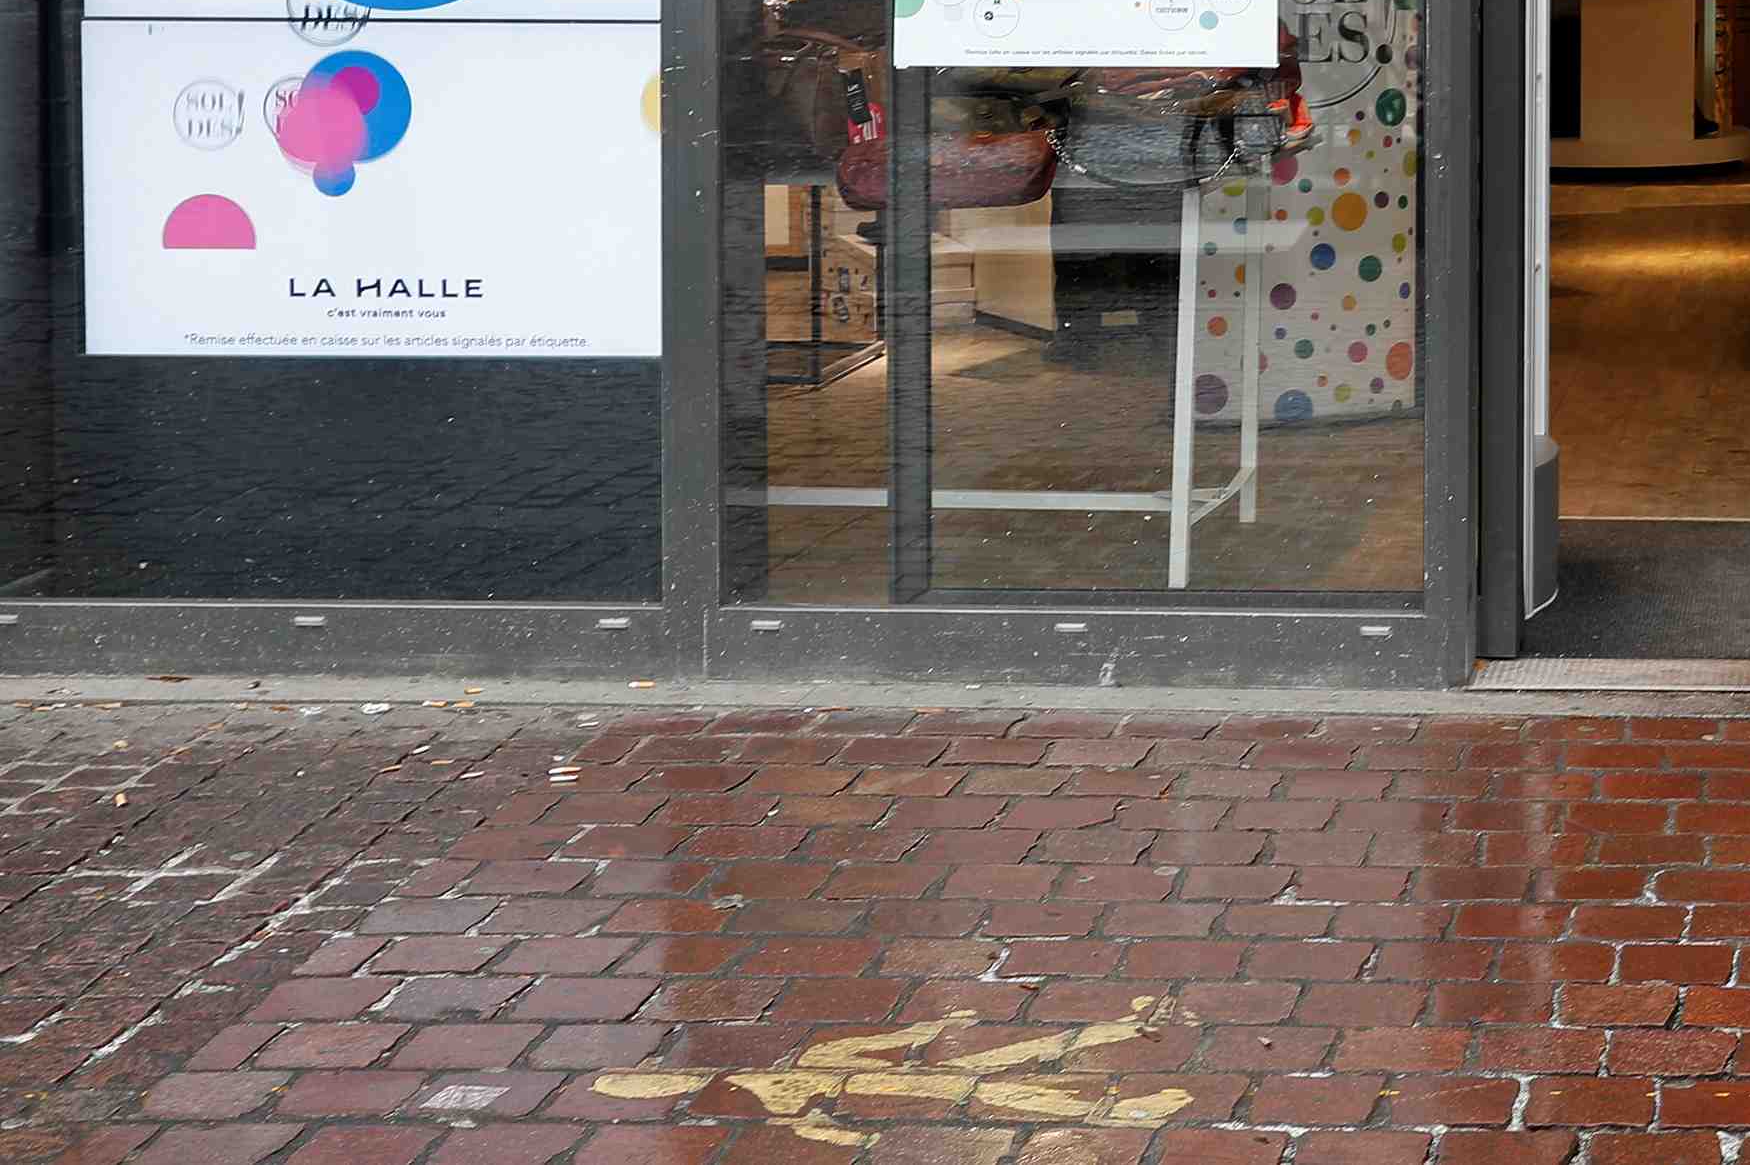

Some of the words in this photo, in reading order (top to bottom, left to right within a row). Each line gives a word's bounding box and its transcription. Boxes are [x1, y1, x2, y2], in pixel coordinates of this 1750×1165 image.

[290, 278, 337, 298] LA
[356, 278, 484, 298] HALLE
[327, 307, 356, 318] c'est
[360, 308, 414, 318] vraiment
[417, 309, 446, 318] vous
